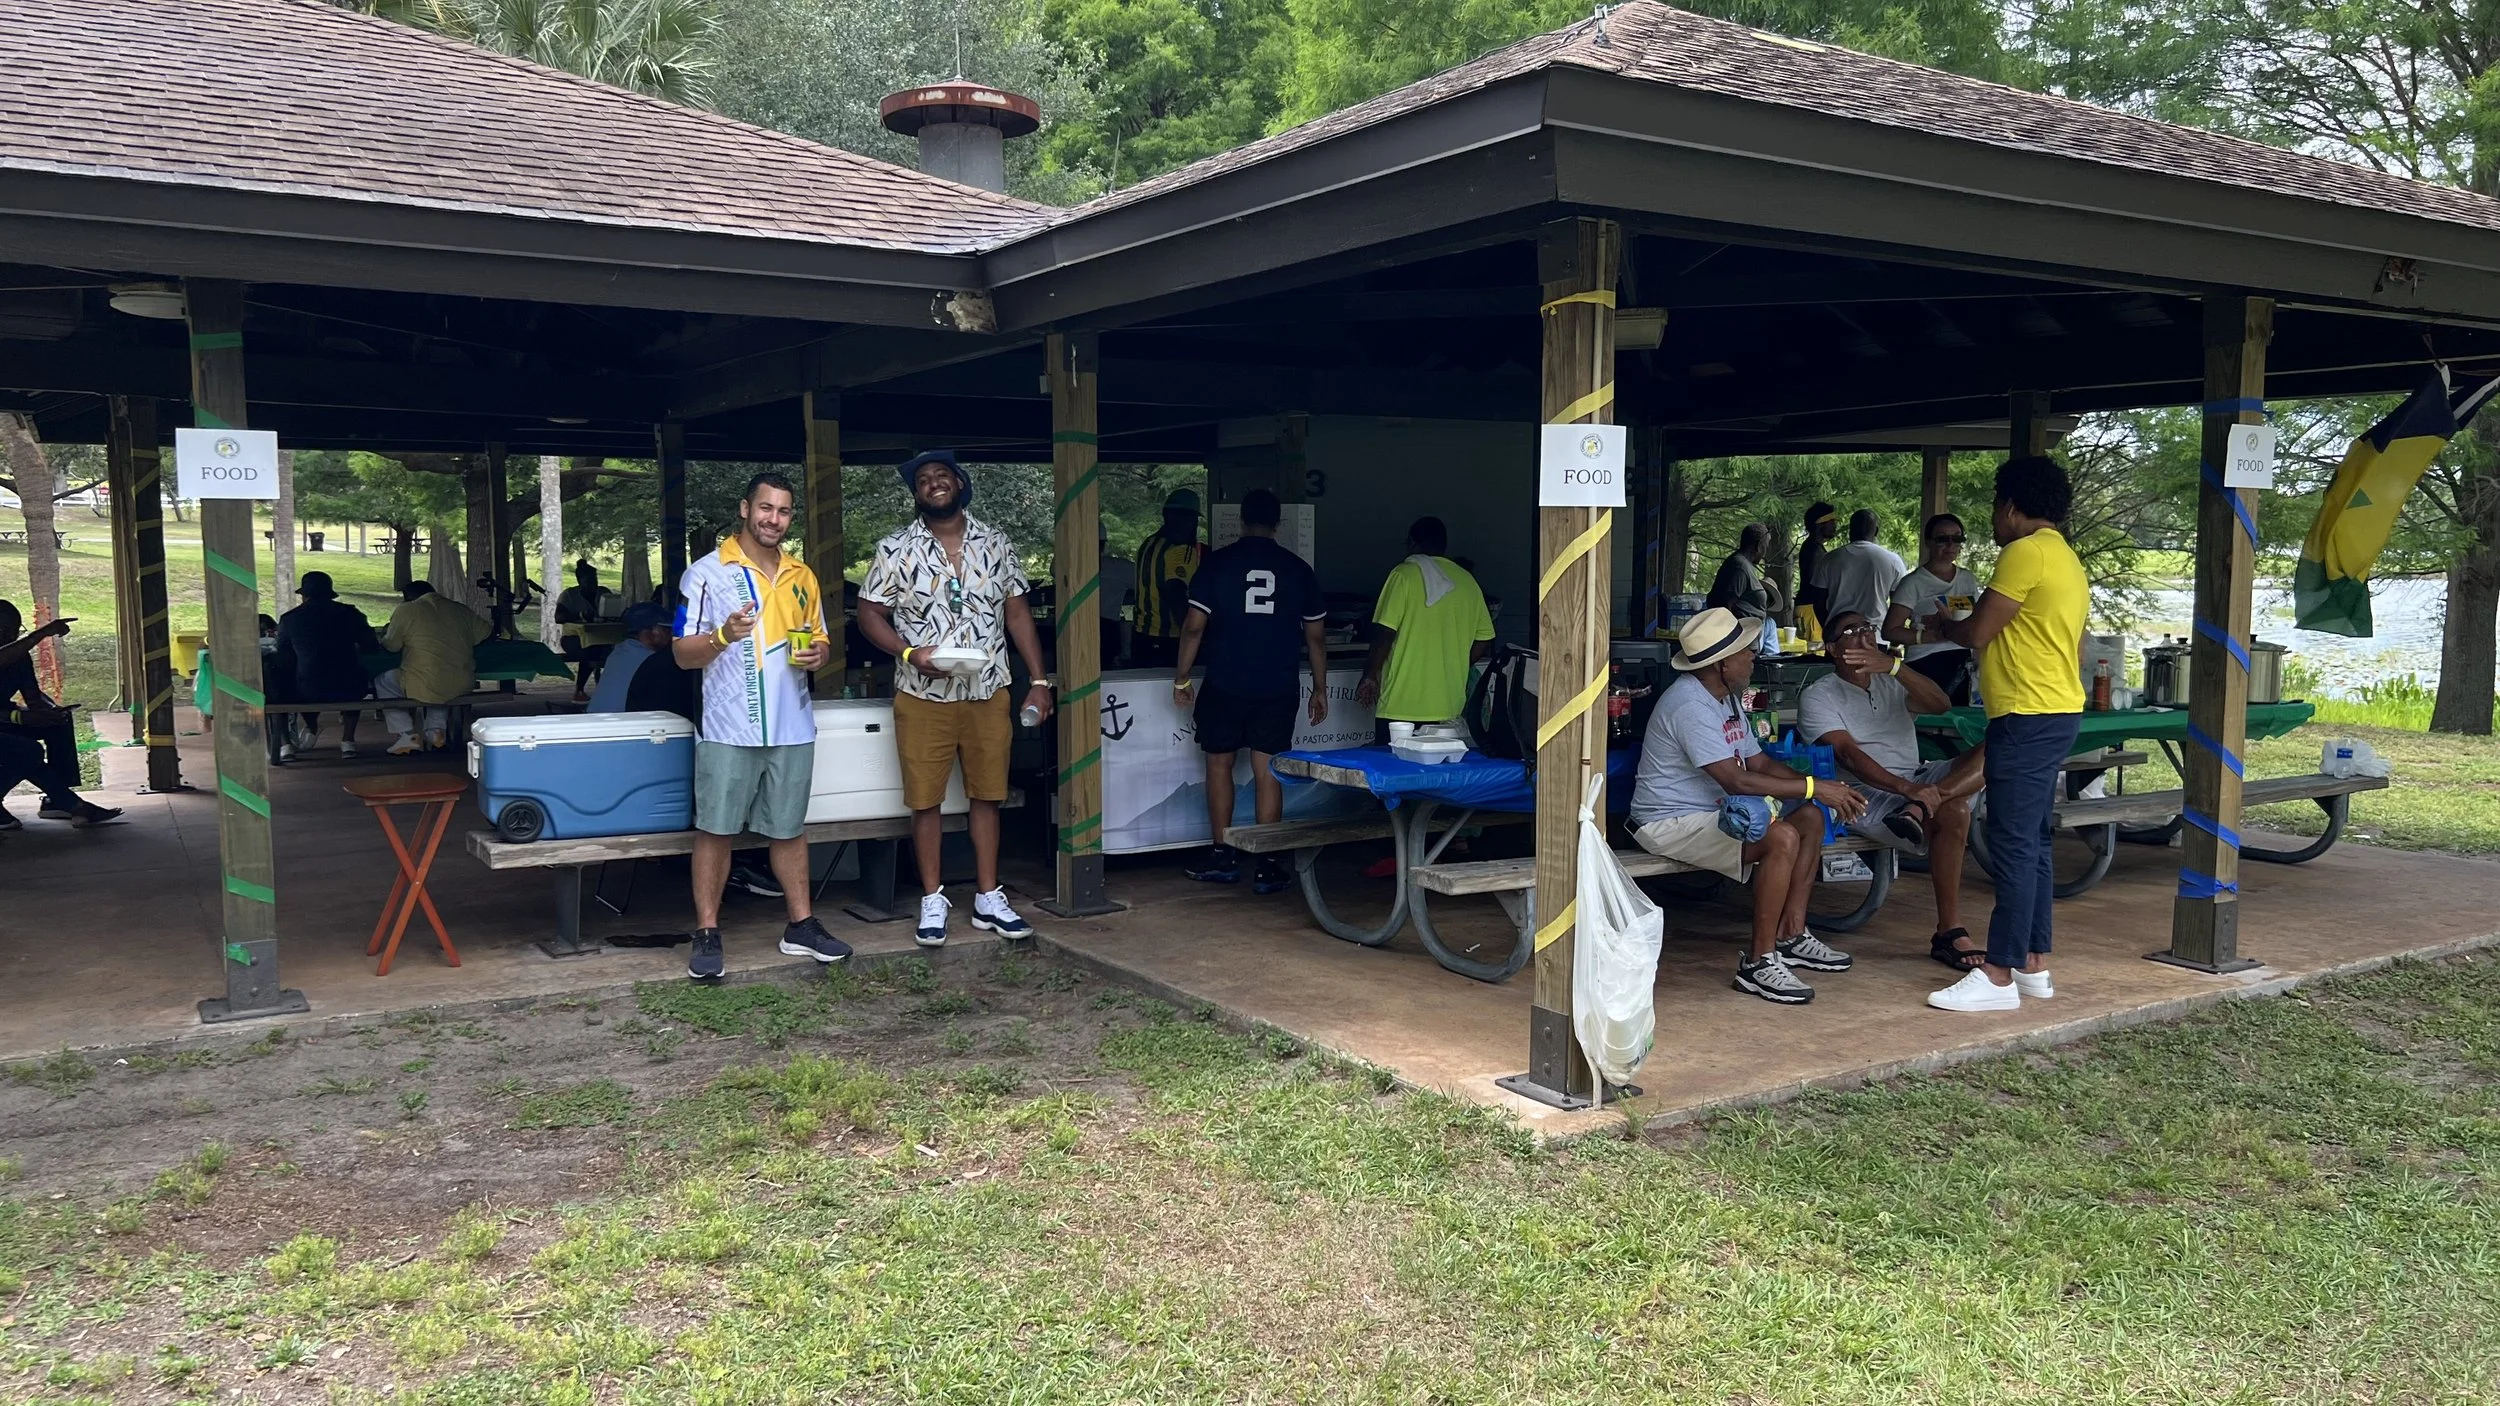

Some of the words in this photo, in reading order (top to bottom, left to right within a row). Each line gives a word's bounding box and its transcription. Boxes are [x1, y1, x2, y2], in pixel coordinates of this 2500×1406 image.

[201, 466, 258, 481] FOOD
[2237, 459, 2264, 472] FOOD
[1305, 469, 1326, 498] 3
[1563, 469, 1612, 485] FOOD
[1245, 569, 1276, 615] 2
[742, 640, 755, 658] AND
[744, 659, 758, 697] VINCENT
[747, 698, 760, 724] SAINT
[1302, 734, 1335, 745] PASTOR
[1336, 731, 1363, 742] SANDY
